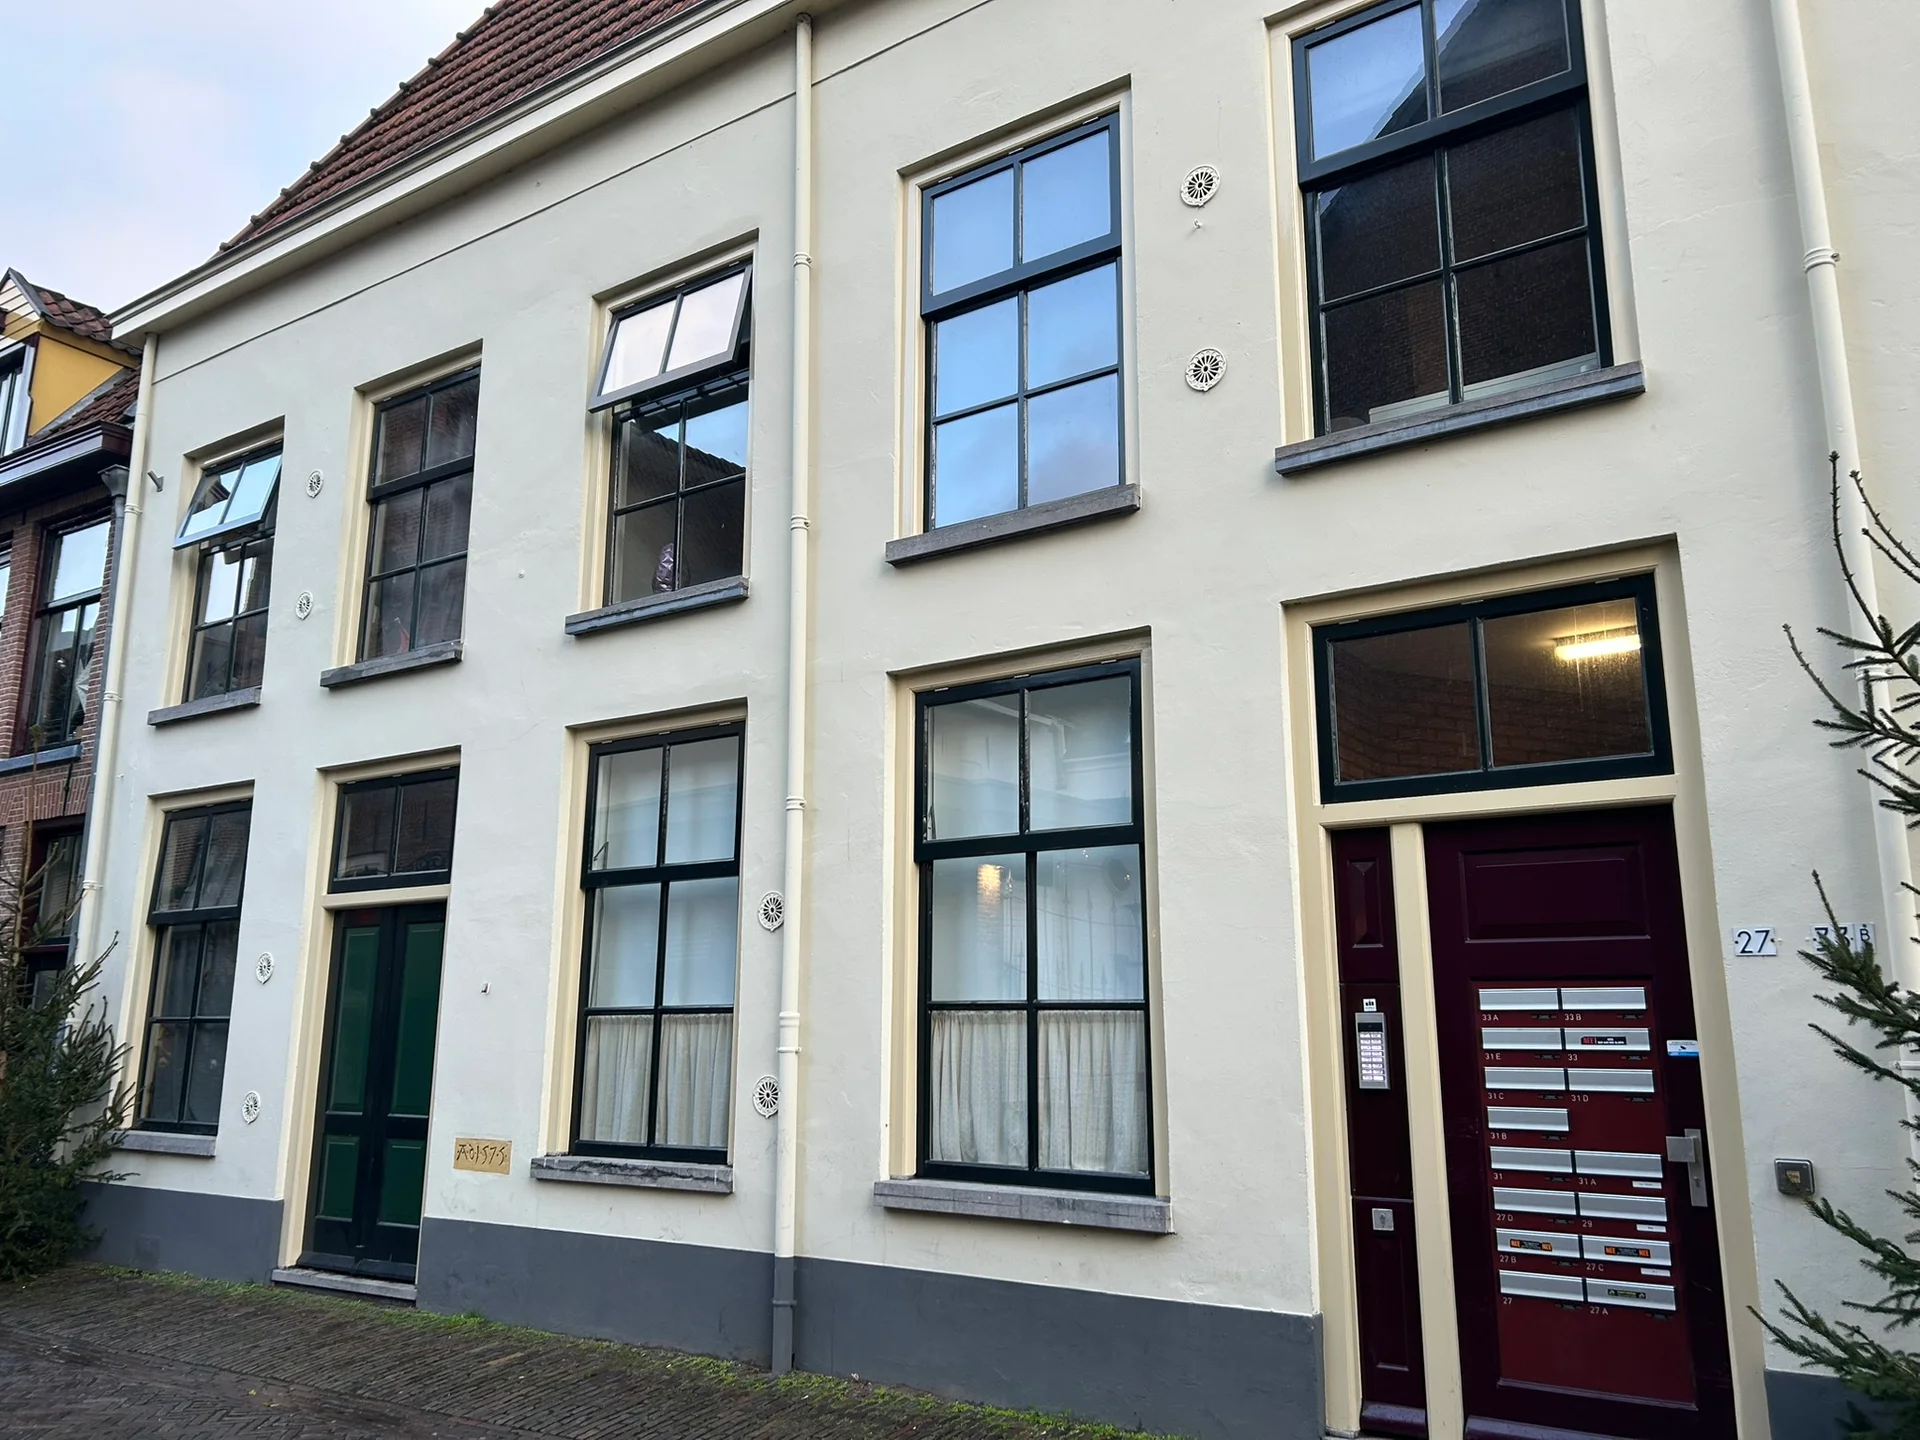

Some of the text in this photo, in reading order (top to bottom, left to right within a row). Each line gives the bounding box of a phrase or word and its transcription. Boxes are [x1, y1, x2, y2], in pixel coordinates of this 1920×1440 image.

[1737, 929, 1771, 954] 27
[1482, 1013, 1492, 1021] 33
[1564, 1013, 1575, 1021] 33
[1485, 1052, 1494, 1060] 31
[1567, 1053, 1578, 1061] 33
[1487, 1092, 1497, 1100] 31
[1571, 1094, 1581, 1102] 31
[1490, 1132, 1500, 1140] 31
[1493, 1172, 1503, 1180] 31
[1578, 1177, 1588, 1185] 31
[1496, 1213, 1506, 1221] 27
[1582, 1219, 1593, 1228] 29
[1499, 1254, 1509, 1263] 27
[1586, 1262, 1596, 1271] 27
[1503, 1296, 1513, 1305] 27
[1590, 1306, 1600, 1314] 27
